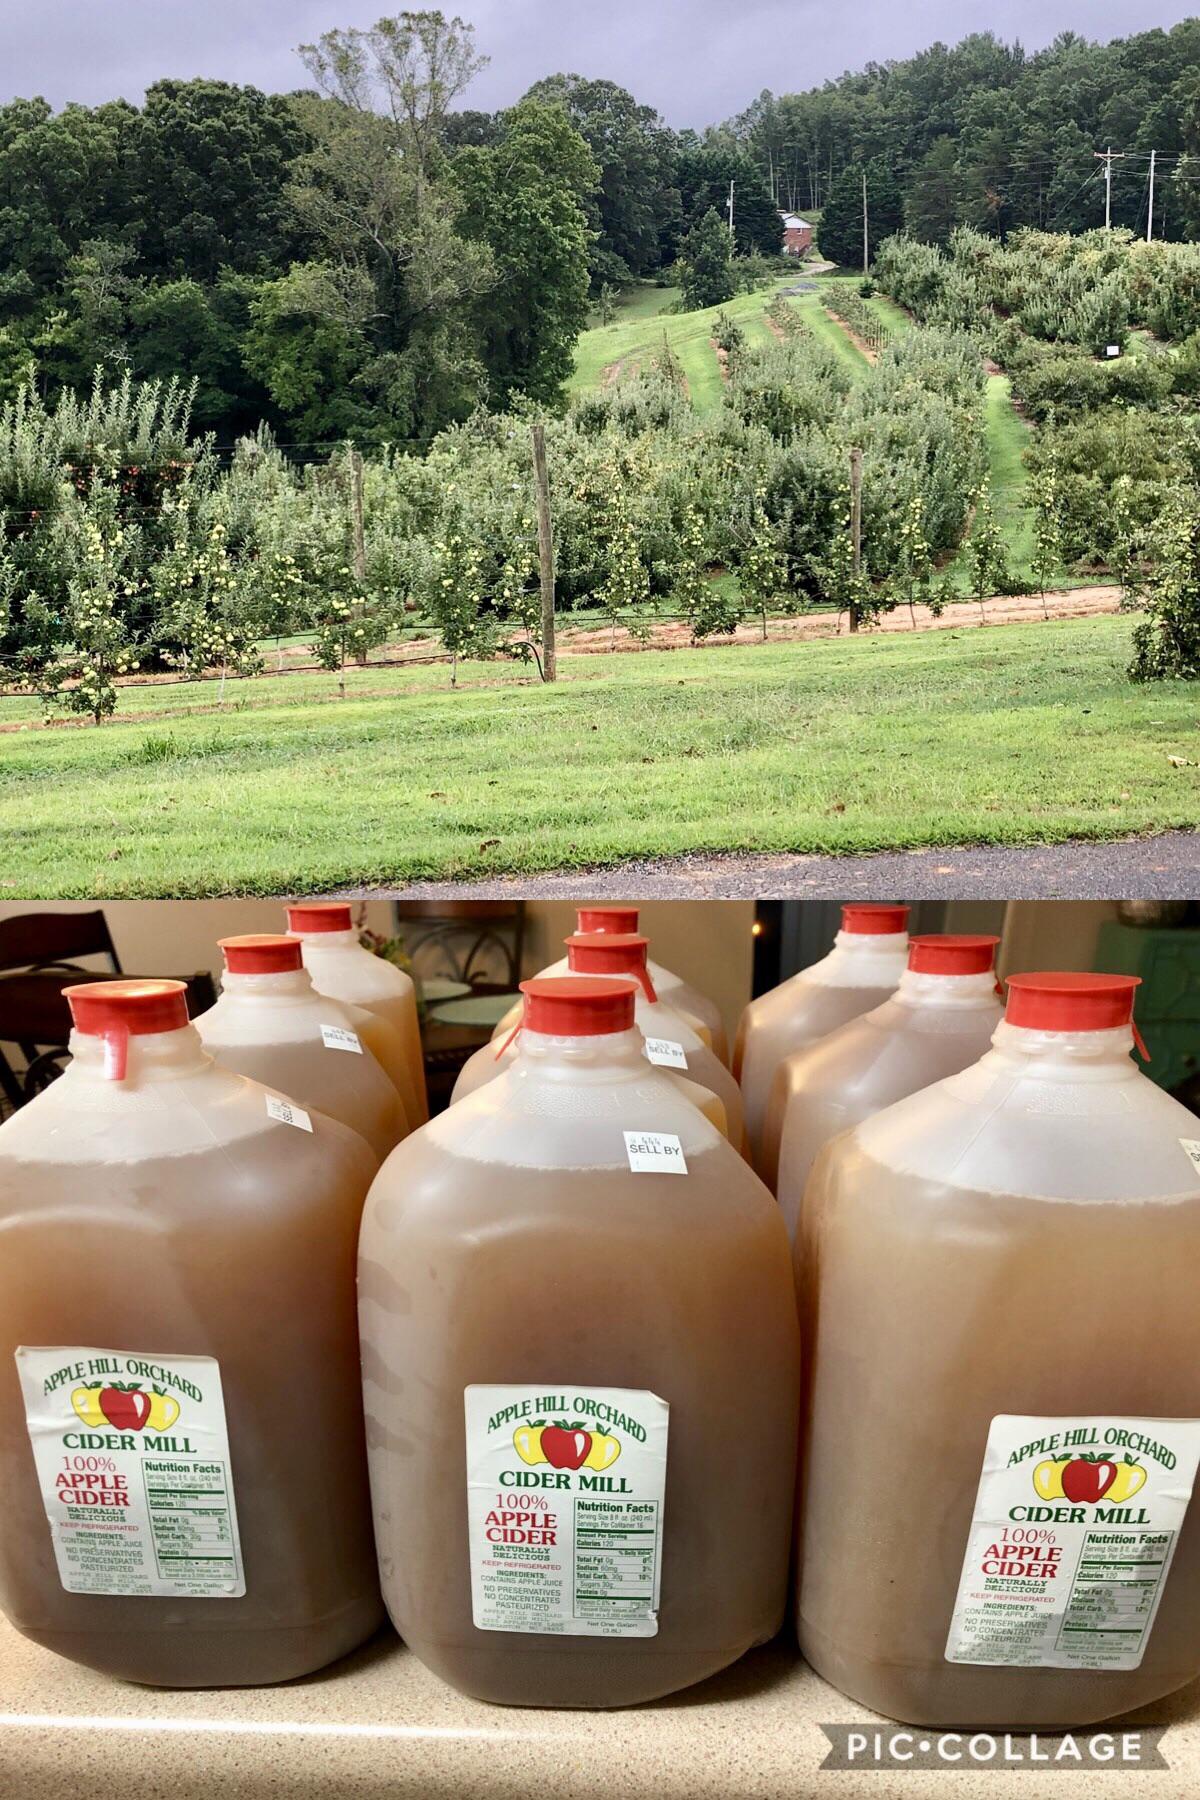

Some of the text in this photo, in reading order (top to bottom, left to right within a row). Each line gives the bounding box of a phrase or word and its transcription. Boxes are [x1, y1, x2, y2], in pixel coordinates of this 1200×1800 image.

[630, 1144, 679, 1155] SELL BY
[43, 1358, 203, 1402] APPLE HILL ORCHARD
[487, 1396, 647, 1443] APPLE HILL ORCHARD
[62, 1433, 197, 1453] CIDER MILL
[1006, 1428, 1177, 1471] APPLE HILL ORCHARD
[62, 1455, 116, 1472] 100%
[145, 1461, 221, 1474] Nutrition Facts
[55, 1472, 128, 1489] APPLE
[499, 1471, 633, 1493] CIDER MILL
[58, 1489, 131, 1507] CIDER
[496, 1493, 548, 1510] 100%
[66, 1506, 125, 1515] NATURALLY
[577, 1501, 655, 1513] Nutrition Facts
[69, 1513, 126, 1522] DELICIOUS
[485, 1511, 558, 1529] APPLE
[1009, 1506, 1151, 1525] CIDER MILL
[81, 1523, 139, 1531] REFRIGERATED
[486, 1528, 557, 1545] CIDER
[1000, 1528, 1056, 1544] 100%
[1087, 1534, 1169, 1544] Nutrition Facts
[79, 1547, 143, 1558] PRESERVATIVES
[492, 1545, 550, 1554] NATURALLY
[983, 1544, 1063, 1562] APPLE
[81, 1555, 144, 1565] CONCENTRATES
[493, 1552, 550, 1561] DELICIOUS
[80, 1563, 134, 1572] PASTEURIZED
[504, 1561, 561, 1571] REFRIGERATED
[981, 1560, 1058, 1578] CIDER
[481, 1575, 516, 1584] CONTAINS
[497, 1570, 547, 1578] INGREDIENTS:
[985, 1577, 1048, 1587] NATURALLY
[497, 1586, 561, 1596] PRESERVATIVES
[984, 1584, 1046, 1594] DELICIOUS
[499, 1593, 560, 1604] CONCENTRATES
[993, 1594, 1056, 1603] REFRIGERATED
[496, 1602, 549, 1611] PASTEURIZED
[983, 1602, 1038, 1611] INGREDIENTS:
[964, 1608, 1001, 1617] CONTAINS
[1004, 1610, 1029, 1618] APPLE
[980, 1618, 1048, 1629] PRESERVATIVES
[964, 1625, 1046, 1636] NO CONCENTRATES
[974, 1634, 1031, 1644] PASTEURIZED
